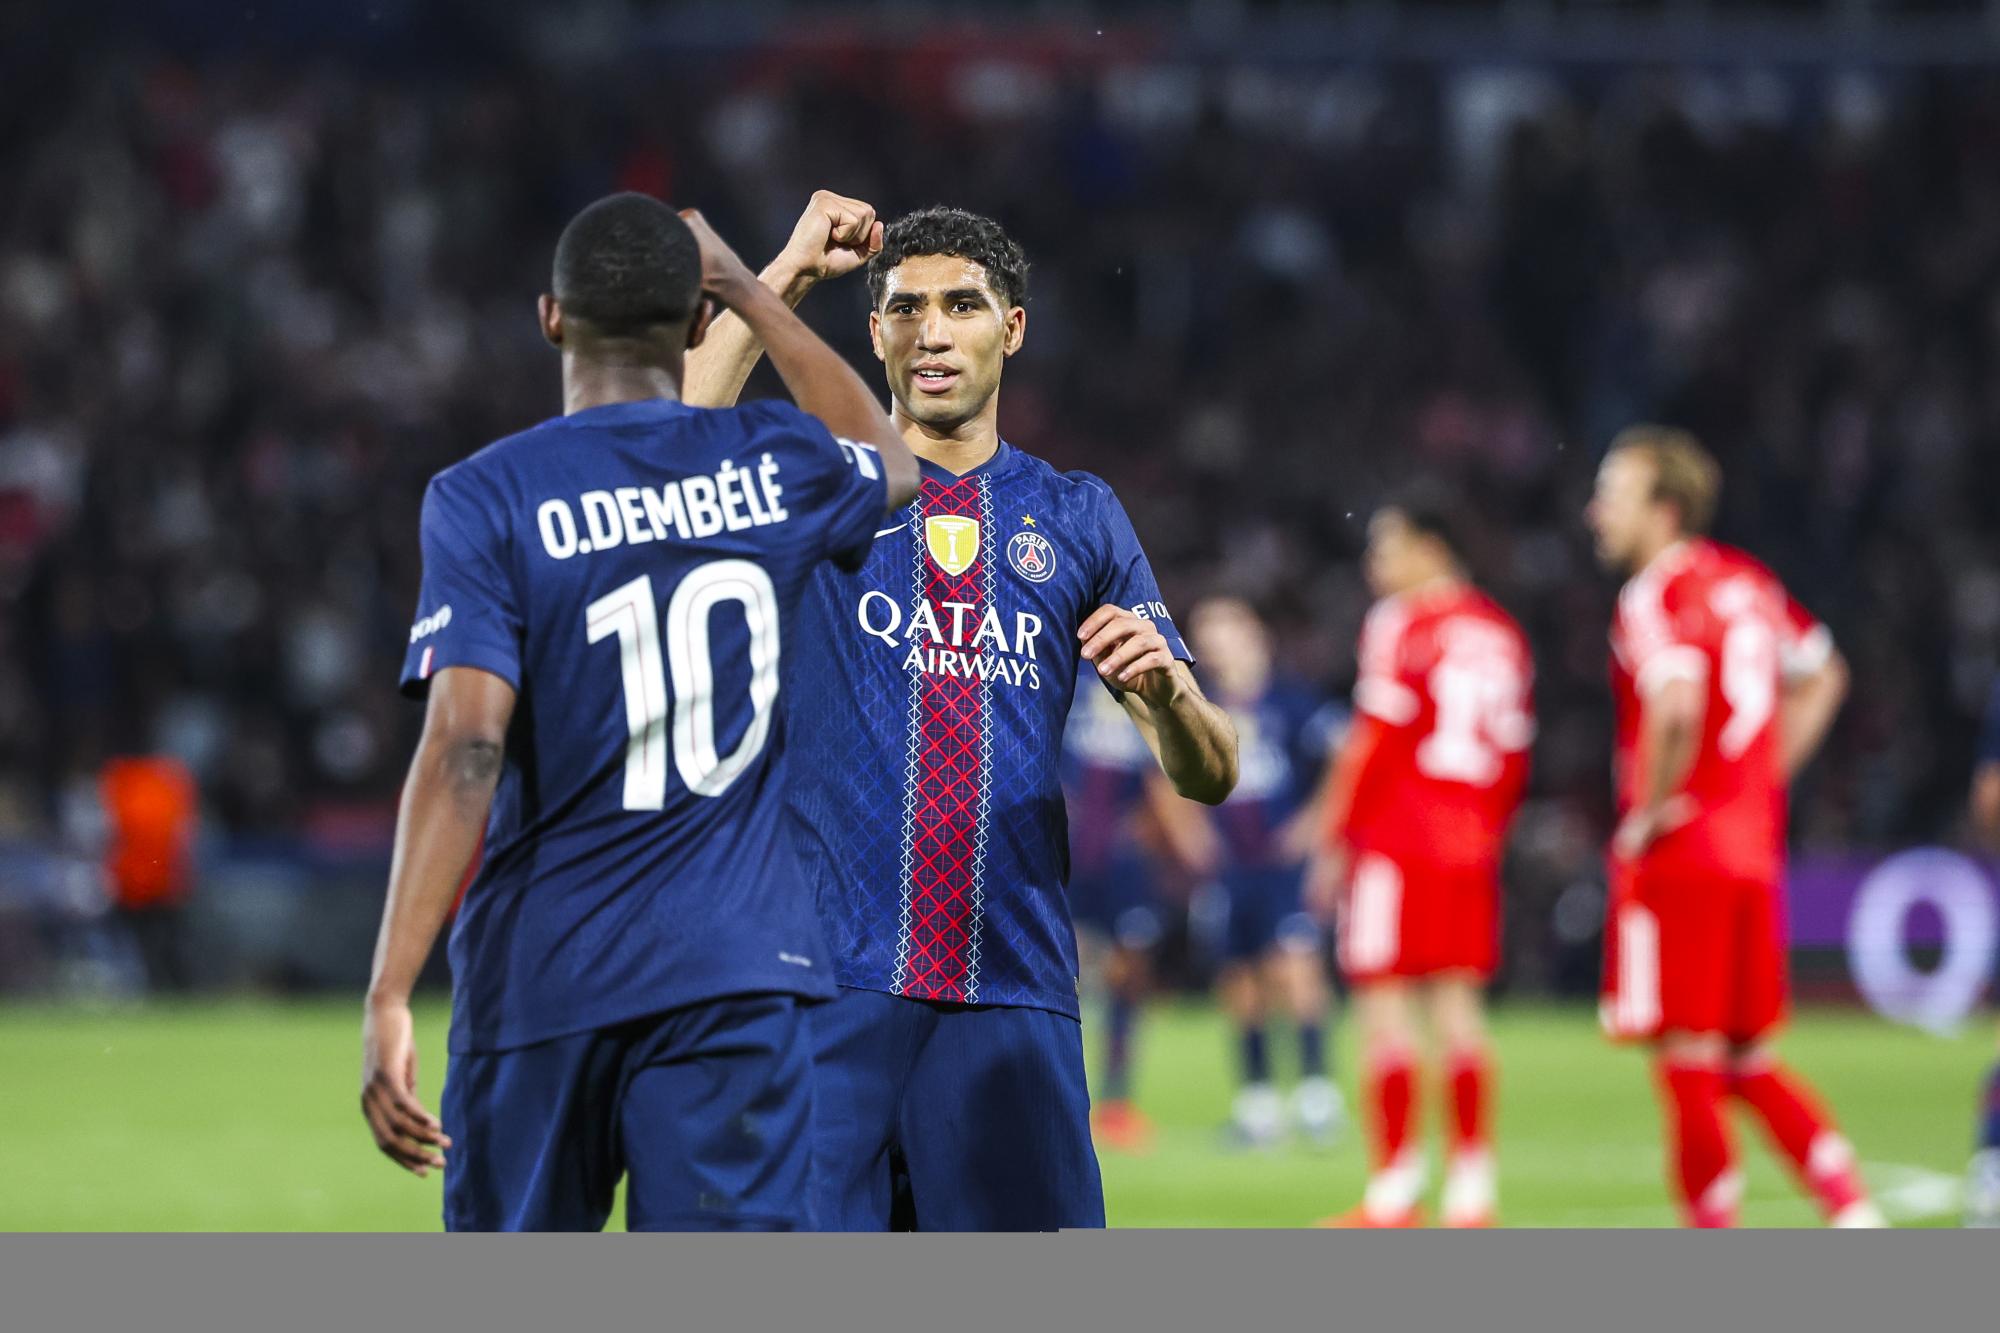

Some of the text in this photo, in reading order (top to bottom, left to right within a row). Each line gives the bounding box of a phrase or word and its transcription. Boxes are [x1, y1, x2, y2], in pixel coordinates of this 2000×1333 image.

[536, 453, 789, 560] O.DEMBÉLÉ
[1015, 534, 1047, 550] PARIS
[857, 590, 1043, 660] QATAR
[585, 559, 780, 812] 10
[902, 646, 1041, 690] AIRWAYS
